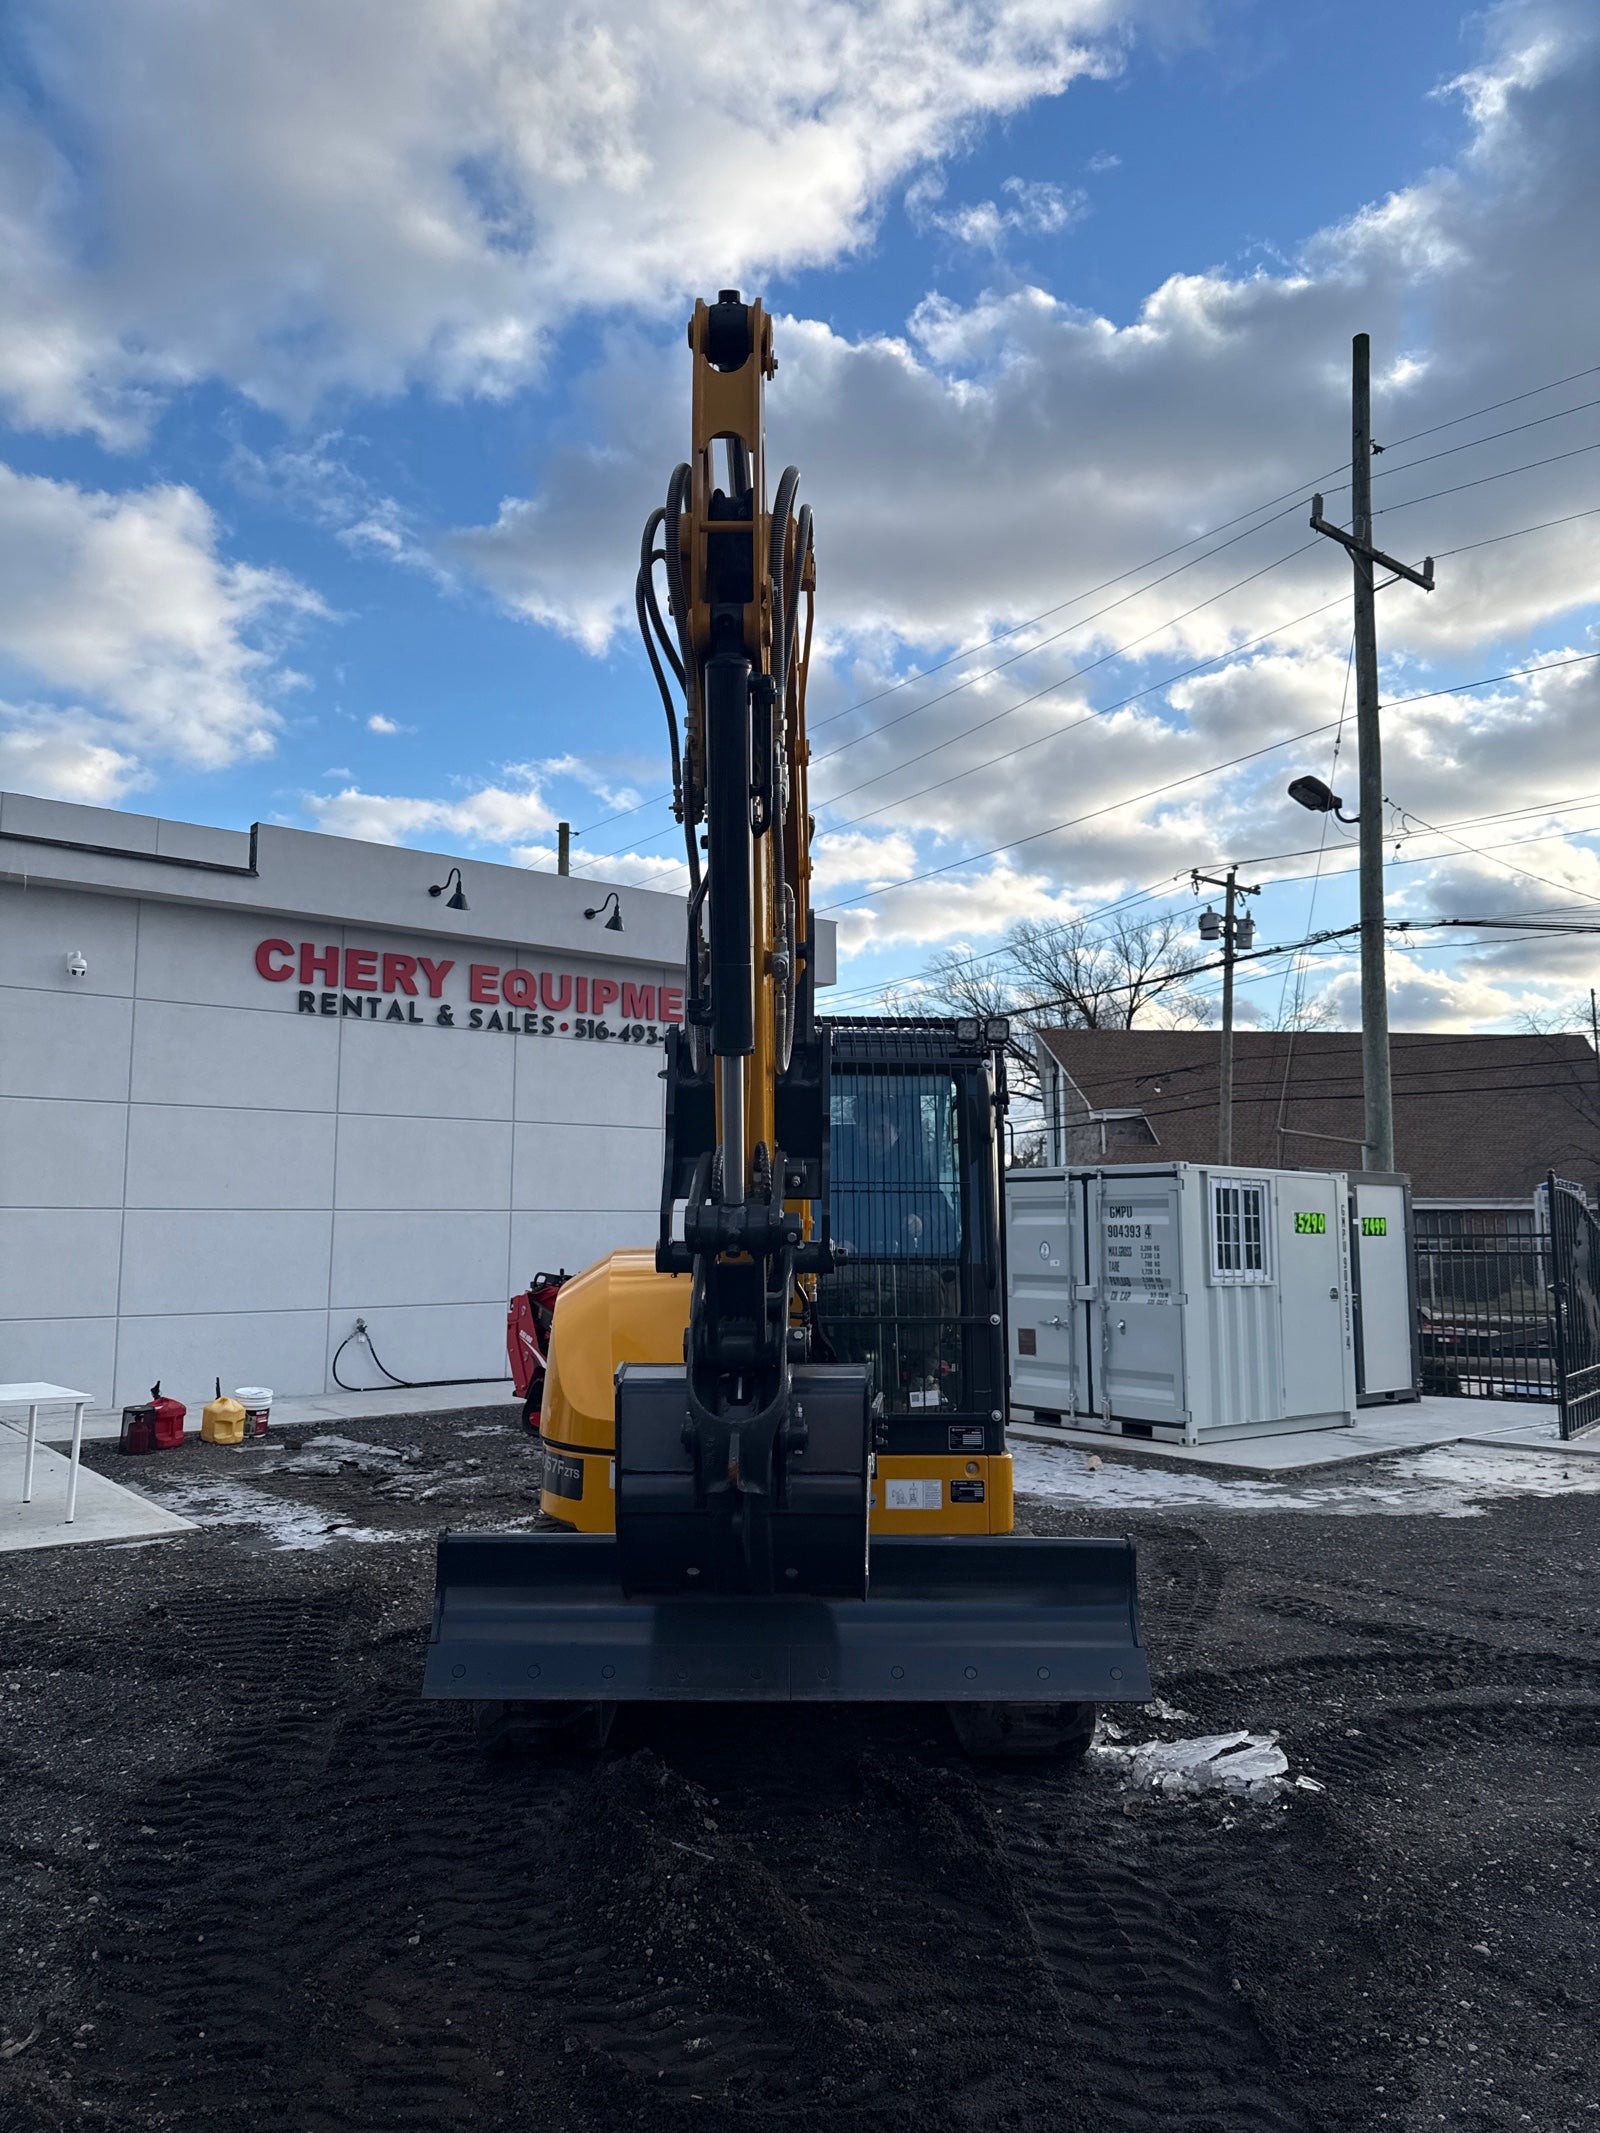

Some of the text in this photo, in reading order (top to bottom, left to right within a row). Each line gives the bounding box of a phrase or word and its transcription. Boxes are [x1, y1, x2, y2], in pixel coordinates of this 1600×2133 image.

[255, 938, 684, 1023] CHERY EQUIPME
[298, 990, 673, 1045] RENTAL & SALES 516-493-
[1109, 1205, 1133, 1218] GMPU
[1107, 1224, 1141, 1238] 904393
